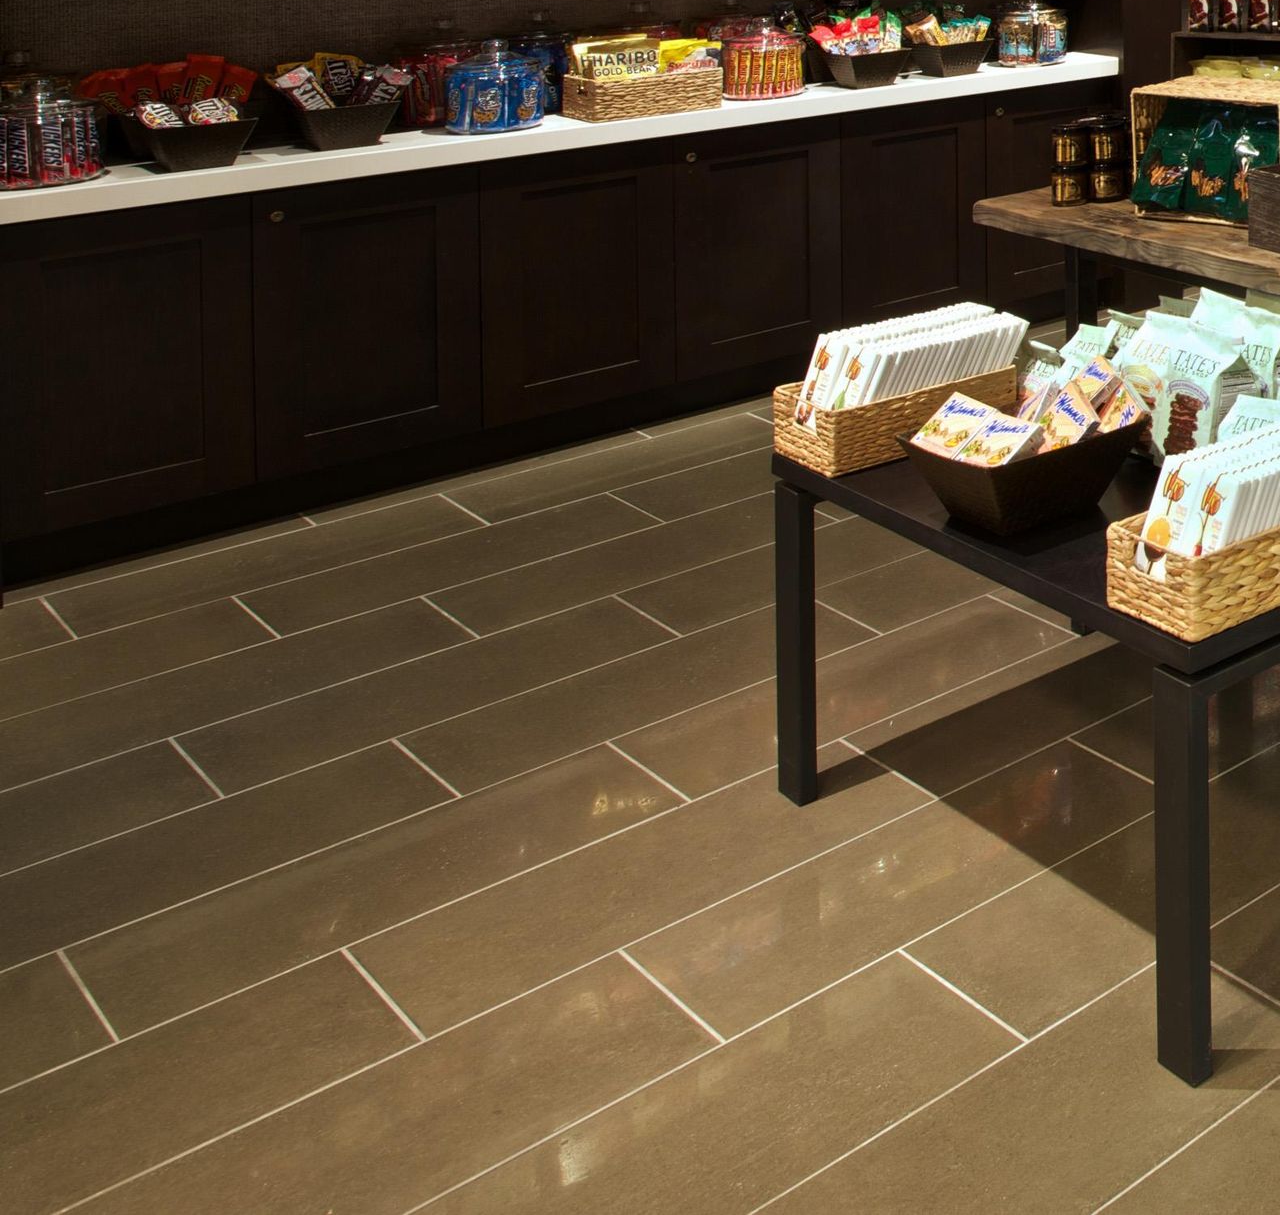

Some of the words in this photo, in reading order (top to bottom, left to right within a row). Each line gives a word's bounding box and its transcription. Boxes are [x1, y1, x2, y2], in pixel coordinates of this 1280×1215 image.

[592, 50, 657, 67] HARIBO
[1242, 344, 1275, 362] ATE'S
[1173, 349, 1221, 376] TATE'S
